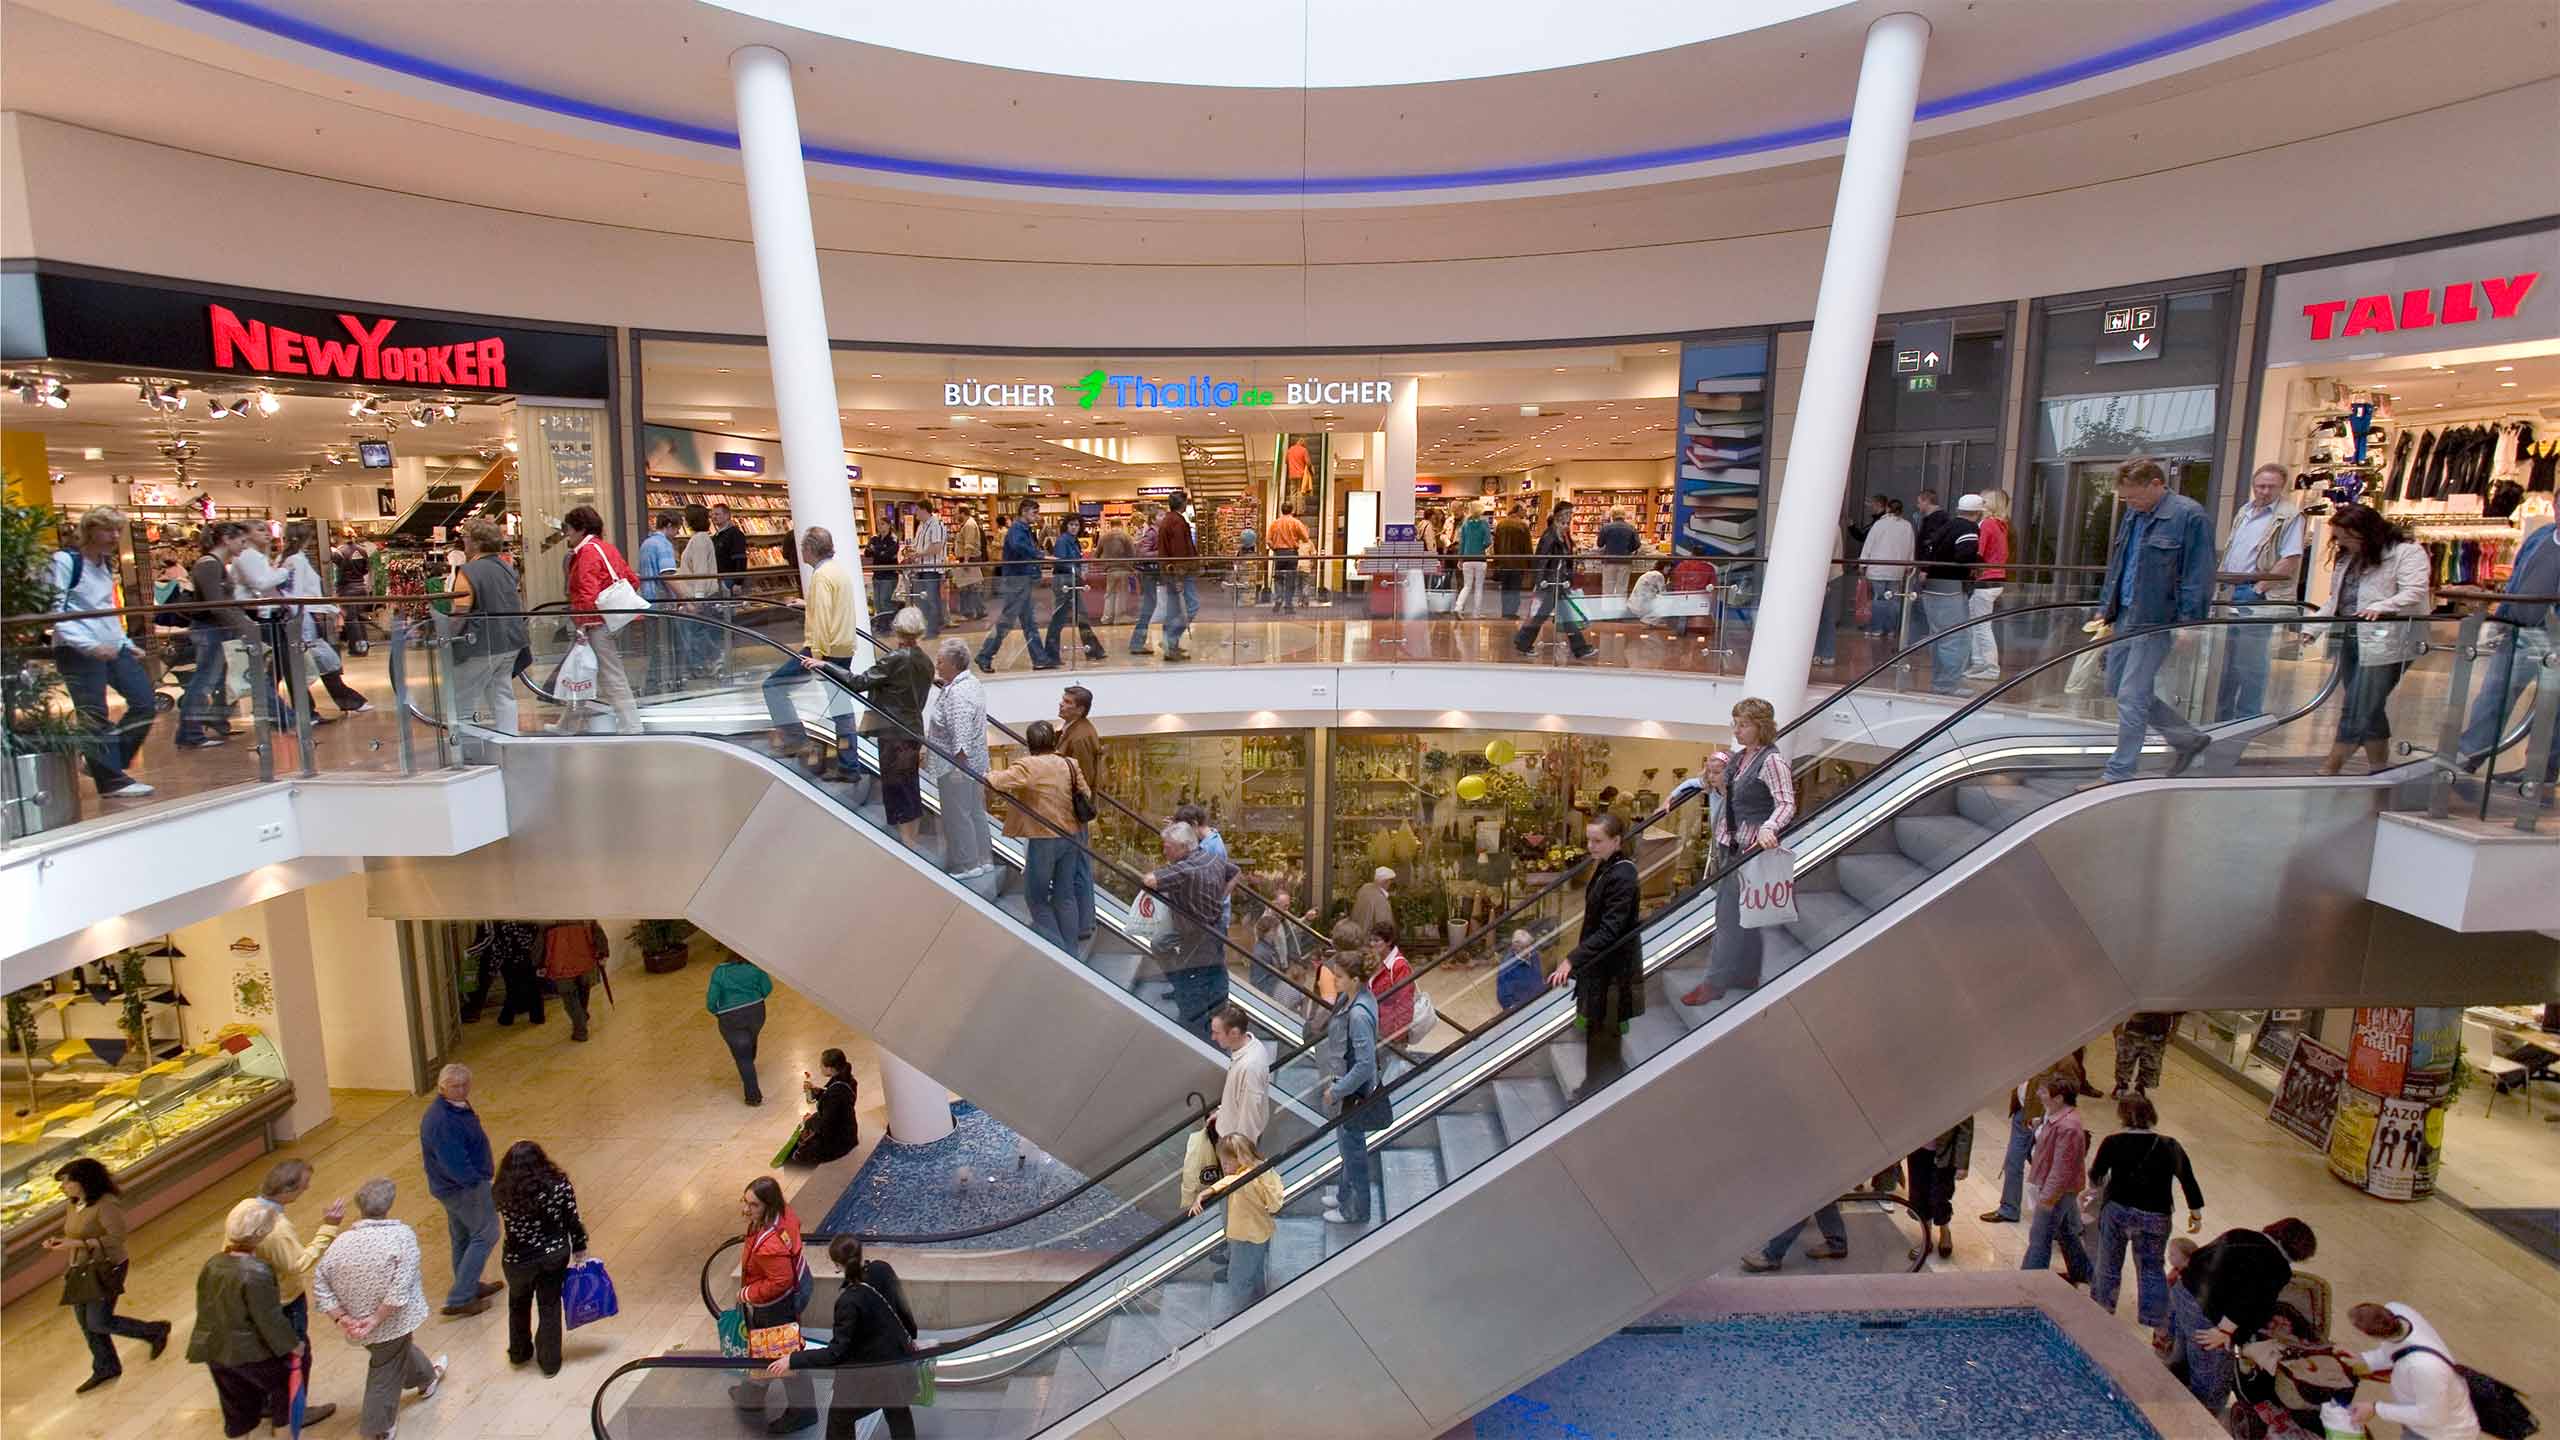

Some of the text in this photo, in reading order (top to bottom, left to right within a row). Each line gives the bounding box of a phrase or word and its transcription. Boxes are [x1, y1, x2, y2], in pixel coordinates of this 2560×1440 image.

[2138, 312, 2150, 326] P
[2303, 272, 2540, 341] TALLY
[943, 378, 1055, 407] BÜCHER
[1286, 377, 1393, 405] BÜCHER
